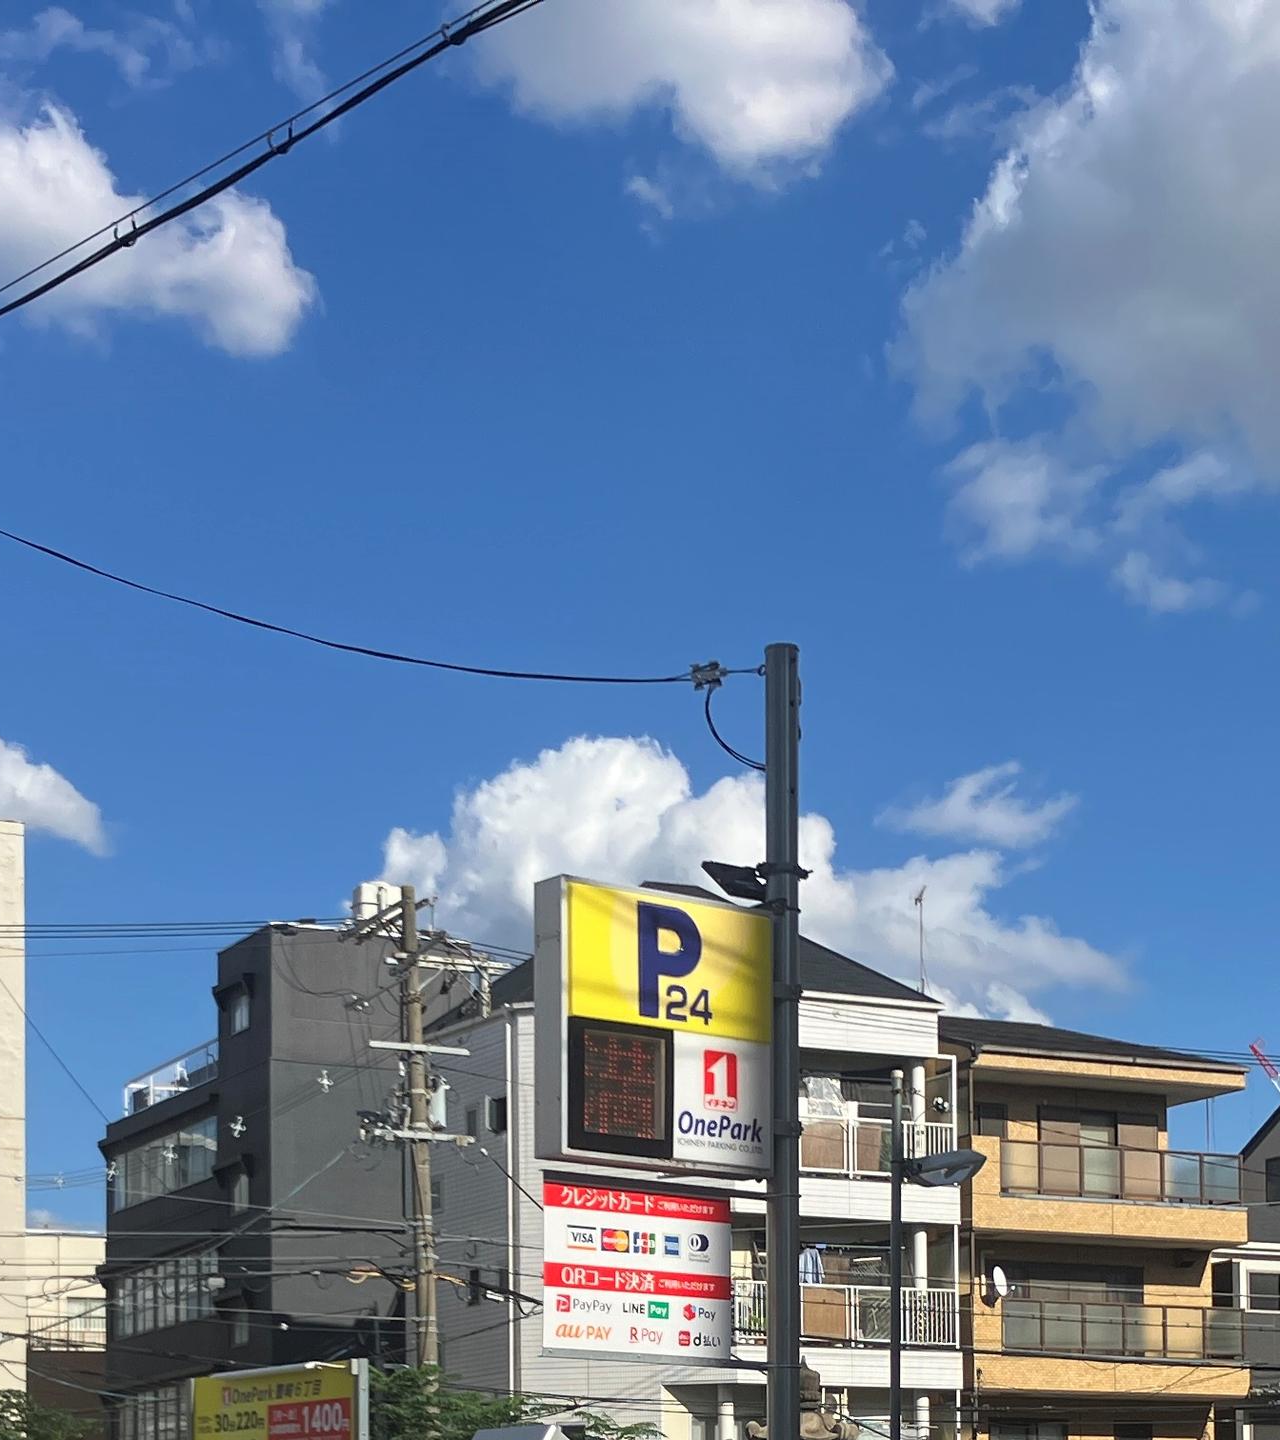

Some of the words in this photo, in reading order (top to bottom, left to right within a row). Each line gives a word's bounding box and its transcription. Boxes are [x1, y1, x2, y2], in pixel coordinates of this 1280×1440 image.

[637, 901, 702, 1018] P
[666, 985, 713, 1025] 24
[678, 1111, 763, 1142] OnePark
[561, 1186, 655, 1213] クレジットカード
[657, 1200, 715, 1215] ご利用いただけます
[571, 1232, 594, 1244] VISA
[561, 1267, 655, 1293] QRコード決済
[658, 1279, 716, 1292] ご利用いただけます
[572, 1298, 612, 1314] PayPay
[622, 1302, 645, 1314] LINE
[650, 1305, 668, 1316] Pay
[698, 1307, 716, 1321] Pay
[555, 1323, 584, 1338] au
[587, 1325, 612, 1340] PAY
[629, 1326, 638, 1341] R
[641, 1328, 663, 1344] Pay
